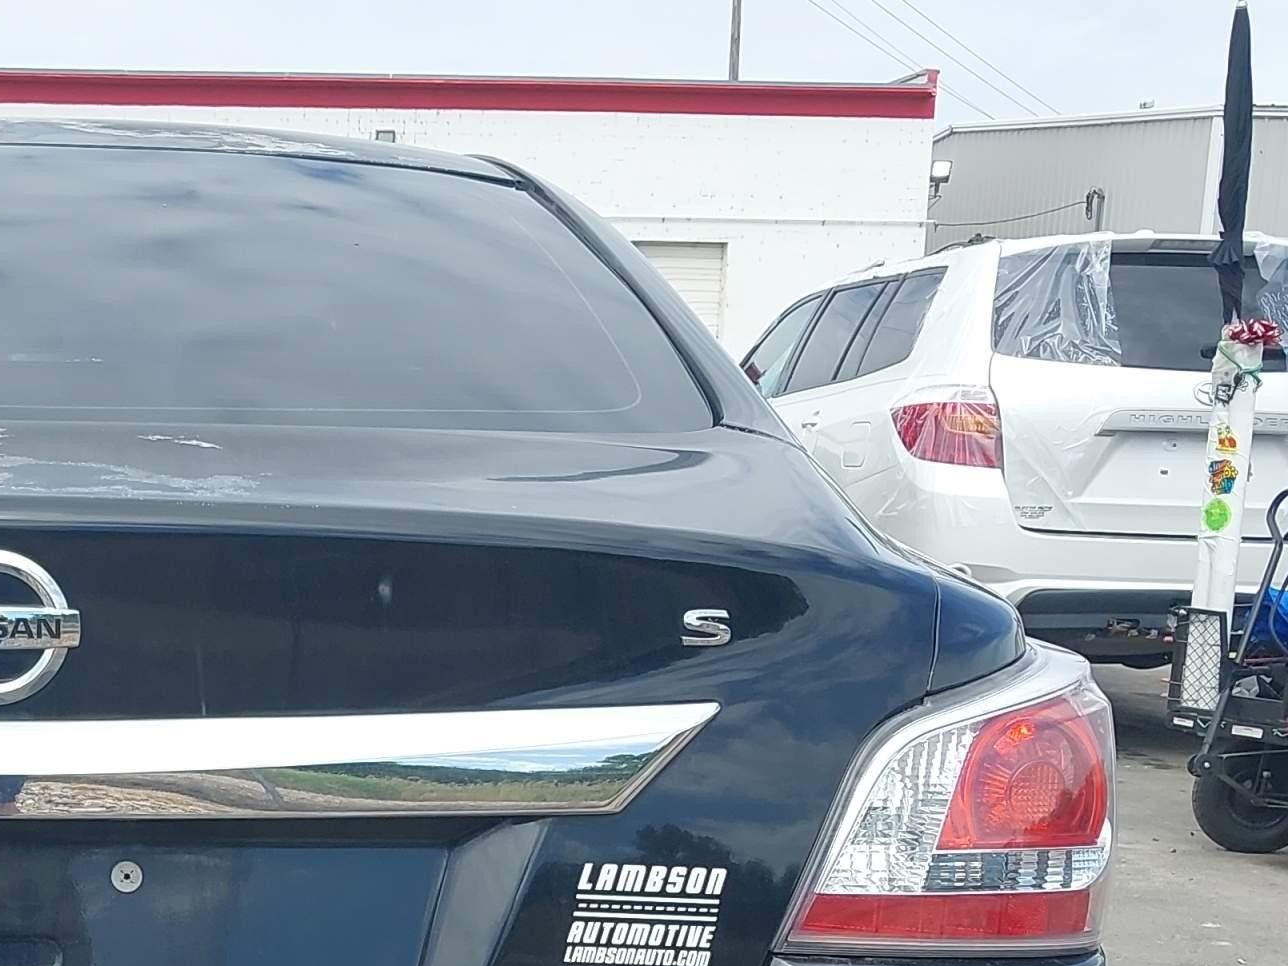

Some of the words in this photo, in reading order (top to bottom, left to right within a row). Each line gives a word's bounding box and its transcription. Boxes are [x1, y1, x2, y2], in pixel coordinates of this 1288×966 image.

[680, 608, 732, 646] S
[577, 862, 728, 895] LAMBSON
[566, 920, 716, 949] AUTOMOTIVE
